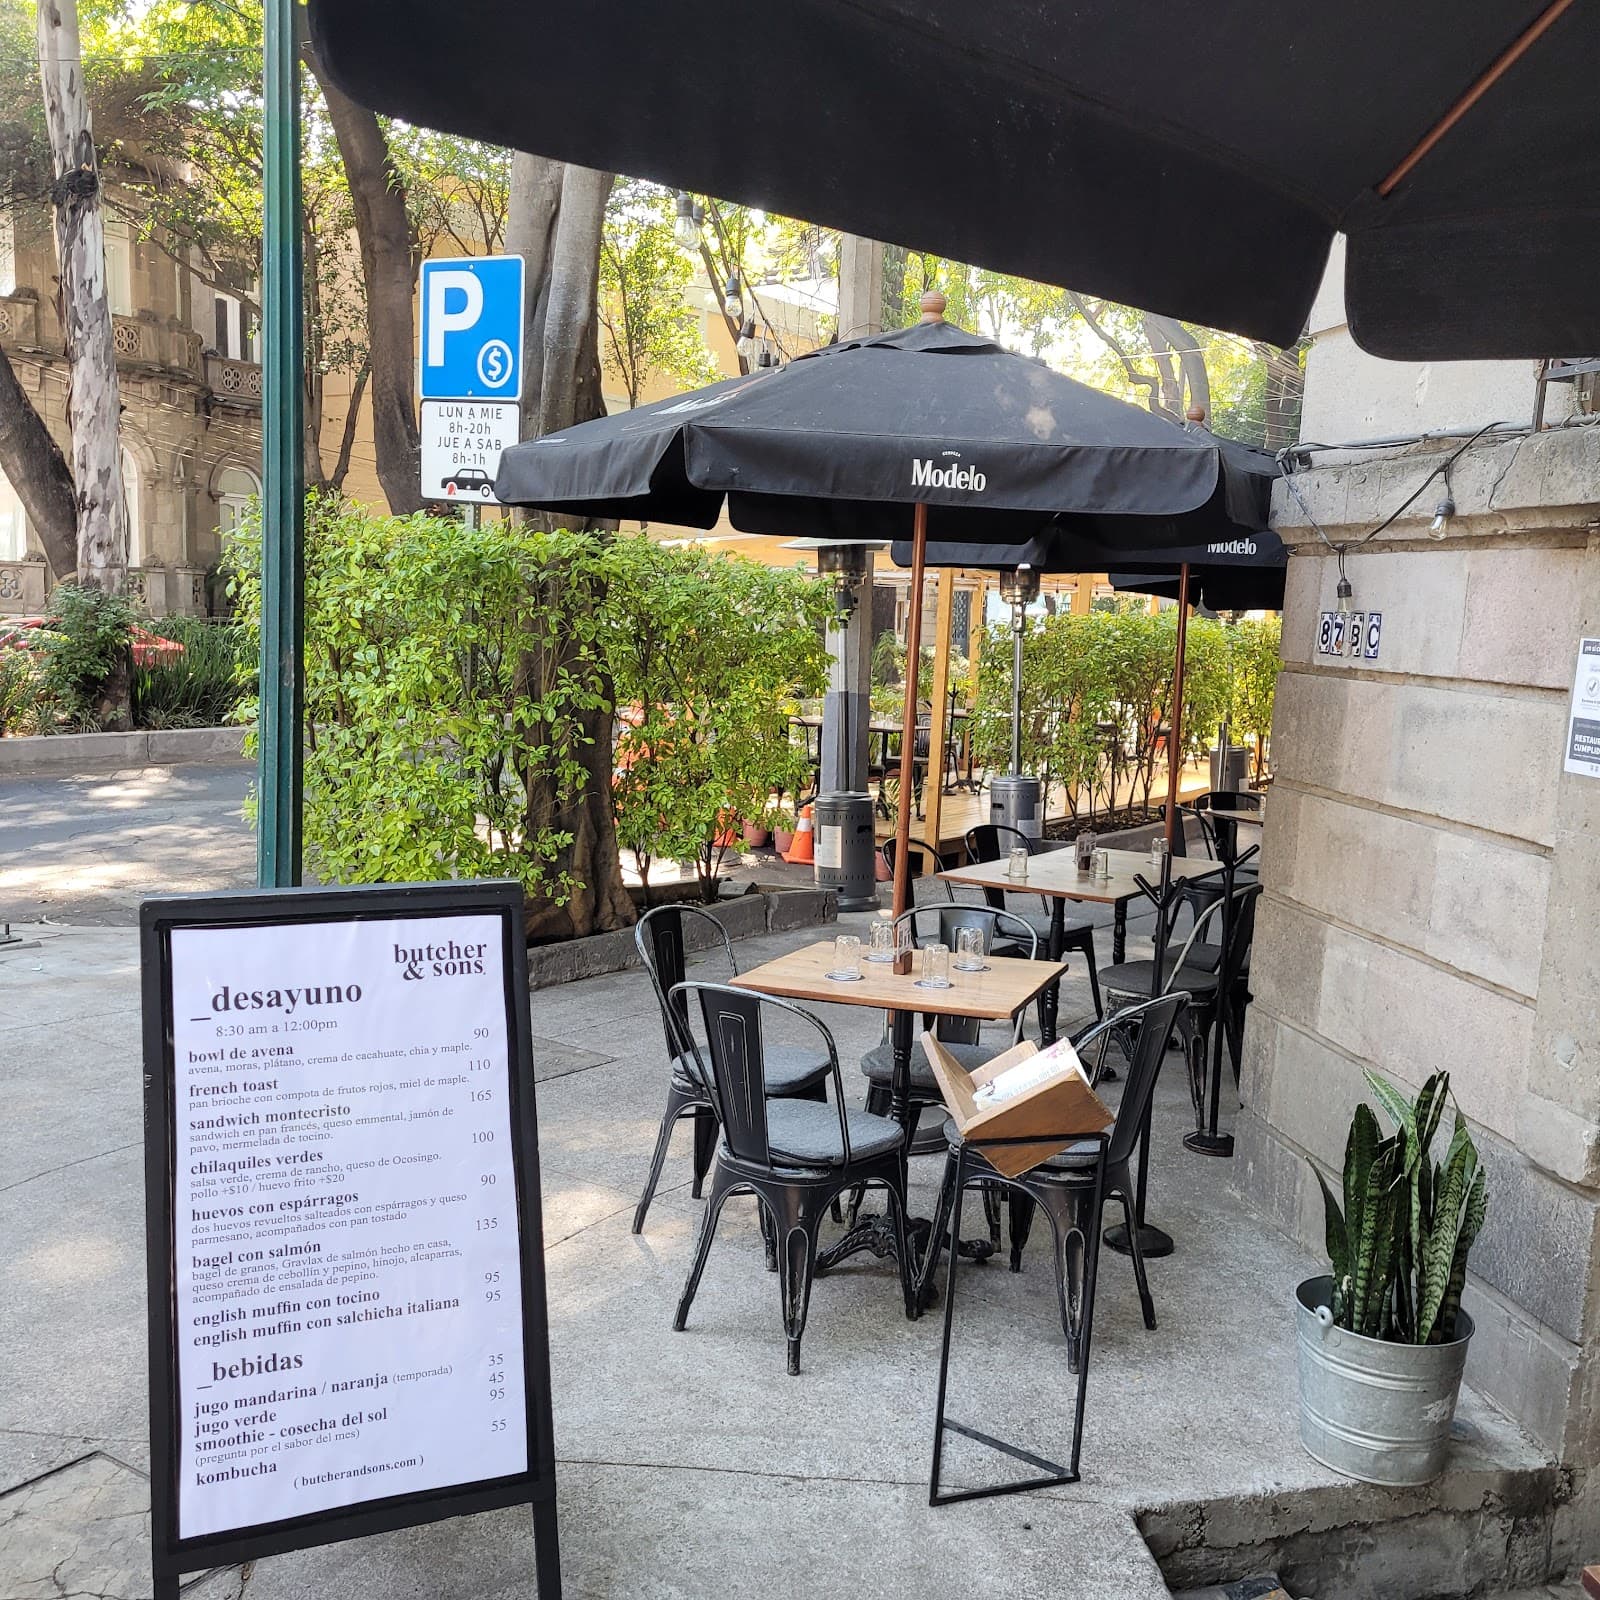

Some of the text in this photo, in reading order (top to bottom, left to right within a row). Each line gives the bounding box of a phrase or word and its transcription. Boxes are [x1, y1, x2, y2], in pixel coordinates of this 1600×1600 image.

[428, 270, 484, 367] P
[438, 406, 503, 420] LUN A MIE
[449, 422, 491, 435] 8h-20h
[437, 436, 503, 451] JUE A SAB
[452, 452, 486, 465] 8h-1h
[911, 458, 986, 492] Modelo
[393, 940, 486, 962] butcher
[402, 959, 424, 980] &
[215, 1019, 338, 1037] 8:30 am a 12:00pm
[473, 1027, 489, 1039] 90
[188, 1046, 294, 1063] bowl de avena
[306, 1055, 338, 1064] crema
[340, 1052, 353, 1061] de
[468, 1058, 491, 1071] 110
[188, 1100, 209, 1111] pan
[210, 1095, 251, 1106] brioche
[253, 1094, 273, 1102] con
[275, 1090, 320, 1101] compota
[321, 1087, 334, 1096] de
[337, 1086, 367, 1095] frutos
[399, 1078, 421, 1088] miel
[423, 1077, 435, 1086] de
[189, 1079, 278, 1097] french toast
[469, 1089, 492, 1102] 165
[189, 1104, 350, 1130] sandwich montecristo
[189, 1128, 240, 1142] sandwich
[257, 1127, 277, 1137] pan
[322, 1119, 352, 1130] queso
[407, 1108, 440, 1122] jamón
[441, 1106, 454, 1116] de
[221, 1135, 280, 1150] mermelada
[282, 1134, 296, 1143] de
[471, 1130, 494, 1143] 100
[190, 1150, 323, 1175] chilaquiles verdes
[190, 1177, 217, 1188] salsa
[255, 1170, 287, 1181] crema
[289, 1167, 303, 1178] de
[345, 1160, 375, 1172] queso
[377, 1156, 390, 1166] de
[190, 1188, 218, 1202] pollo
[258, 1178, 291, 1192] huevo
[293, 1176, 316, 1187] frito
[480, 1174, 496, 1186] 90
[191, 1192, 359, 1221] huevos con espárragos
[191, 1194, 467, 1234] dos huevos revueltos salteados con espárragos queso
[255, 1221, 326, 1237] acompañados
[328, 1220, 348, 1228] con
[349, 1214, 368, 1228] pan
[370, 1210, 407, 1223] tostado
[475, 1217, 498, 1230] 135
[191, 1265, 221, 1281] bagel
[224, 1266, 237, 1276] de
[281, 1255, 323, 1270] Gravlax
[325, 1253, 339, 1262] de
[341, 1248, 378, 1262] salmón
[379, 1244, 411, 1258] hecho
[192, 1240, 321, 1268] bagel con salmón
[192, 1279, 224, 1294] queso
[226, 1274, 260, 1288] crema
[262, 1272, 275, 1282] de
[484, 1271, 500, 1283] 95
[192, 1286, 260, 1303] acompañado
[262, 1284, 276, 1293] de
[278, 1277, 324, 1291] ensalada
[326, 1274, 339, 1285] de
[485, 1289, 501, 1302] 95
[193, 1290, 380, 1327] english muffin con tocino
[193, 1298, 459, 1347] english muffin con salchicha italiana
[488, 1353, 504, 1366] 35
[488, 1371, 504, 1384] 45
[193, 1401, 229, 1418] jugo
[234, 1386, 317, 1408] mandarina
[331, 1373, 388, 1392] naranja
[489, 1387, 505, 1400] 95
[193, 1410, 276, 1438] jugo verde
[195, 1407, 387, 1452] smoothie cosecha del sol
[491, 1418, 506, 1432] 55
[250, 1446, 269, 1458] por
[283, 1438, 313, 1450] sabor
[315, 1432, 332, 1444] del
[196, 1461, 277, 1485] kombucha
[301, 1458, 416, 1486] butcherandsons.com
